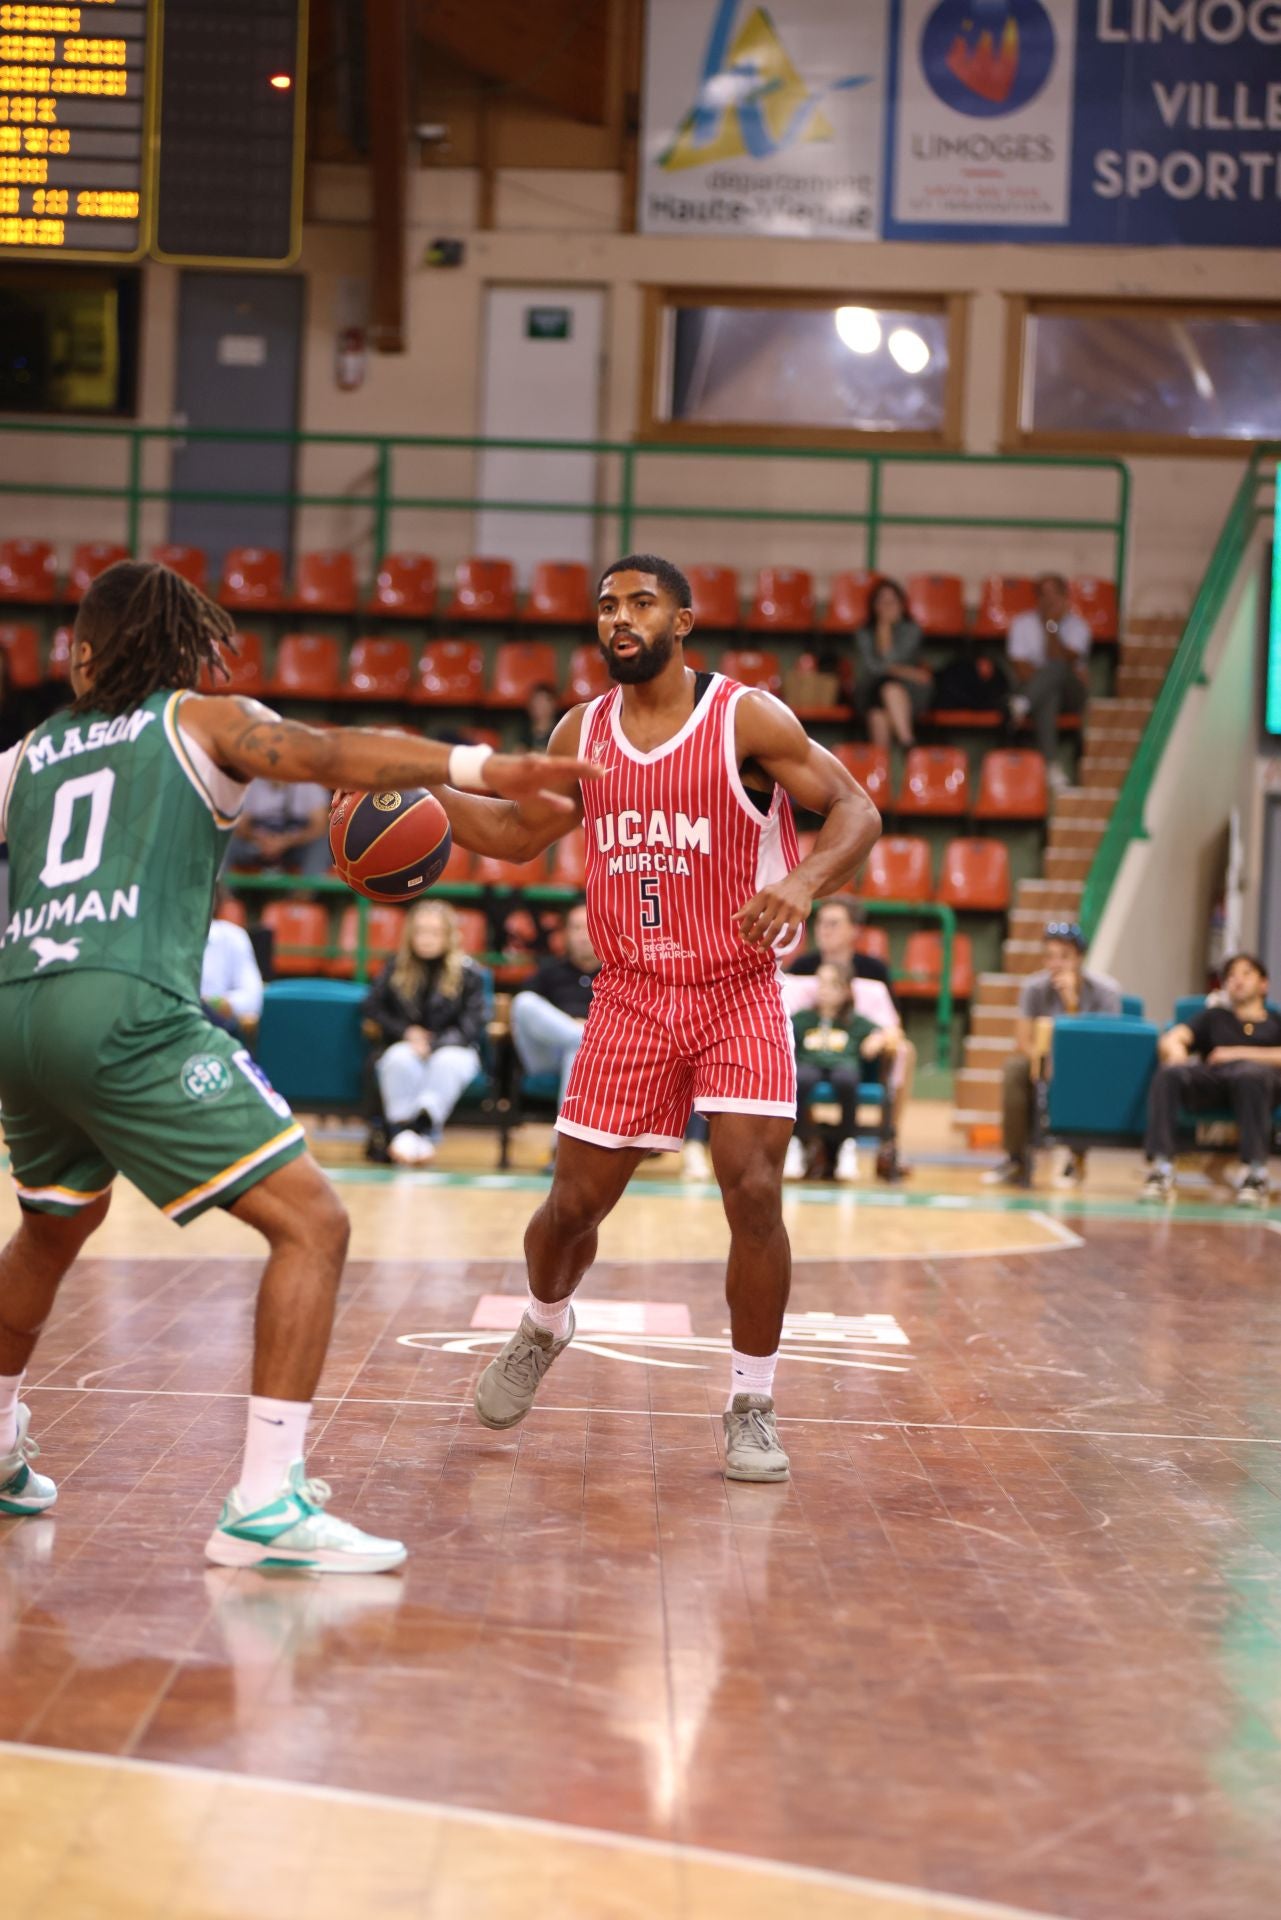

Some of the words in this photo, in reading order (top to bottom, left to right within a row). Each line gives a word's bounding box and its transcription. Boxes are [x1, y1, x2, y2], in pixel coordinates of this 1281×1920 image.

[911, 133, 1056, 163] LIMOGES
[26, 708, 156, 774] MASON
[38, 766, 116, 888] 0
[595, 809, 711, 855] UCAM
[608, 852, 691, 877] MURCIA
[639, 877, 662, 928] 5
[659, 950, 698, 960] MURCIA
